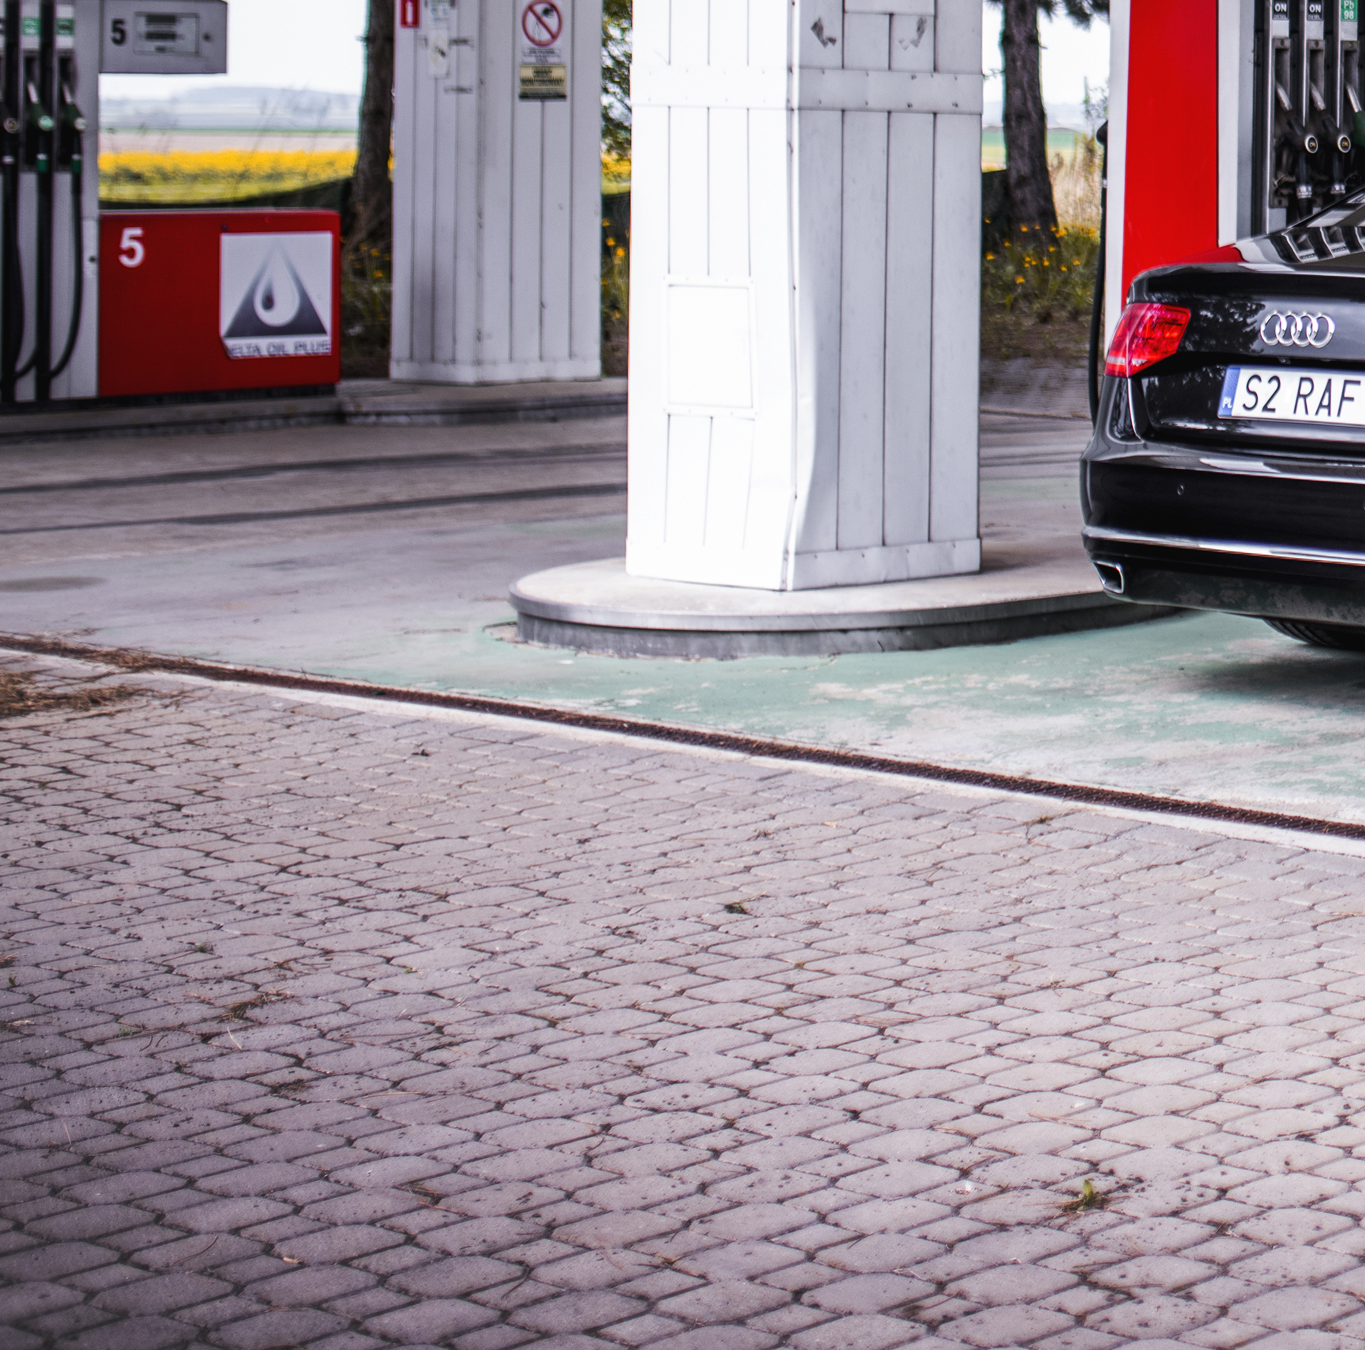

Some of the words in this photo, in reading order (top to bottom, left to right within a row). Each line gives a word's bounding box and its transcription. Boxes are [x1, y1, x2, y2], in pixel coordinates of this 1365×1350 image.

[1274, 3, 1287, 13] ON
[1309, 4, 1322, 13] ON
[1343, 0, 1355, 10] Pb
[1343, 10, 1355, 20] 98
[110, 18, 127, 46] 5
[118, 227, 146, 268] 5
[228, 343, 262, 359] ELTA
[1242, 374, 1281, 413] S2
[1222, 396, 1233, 409] PL
